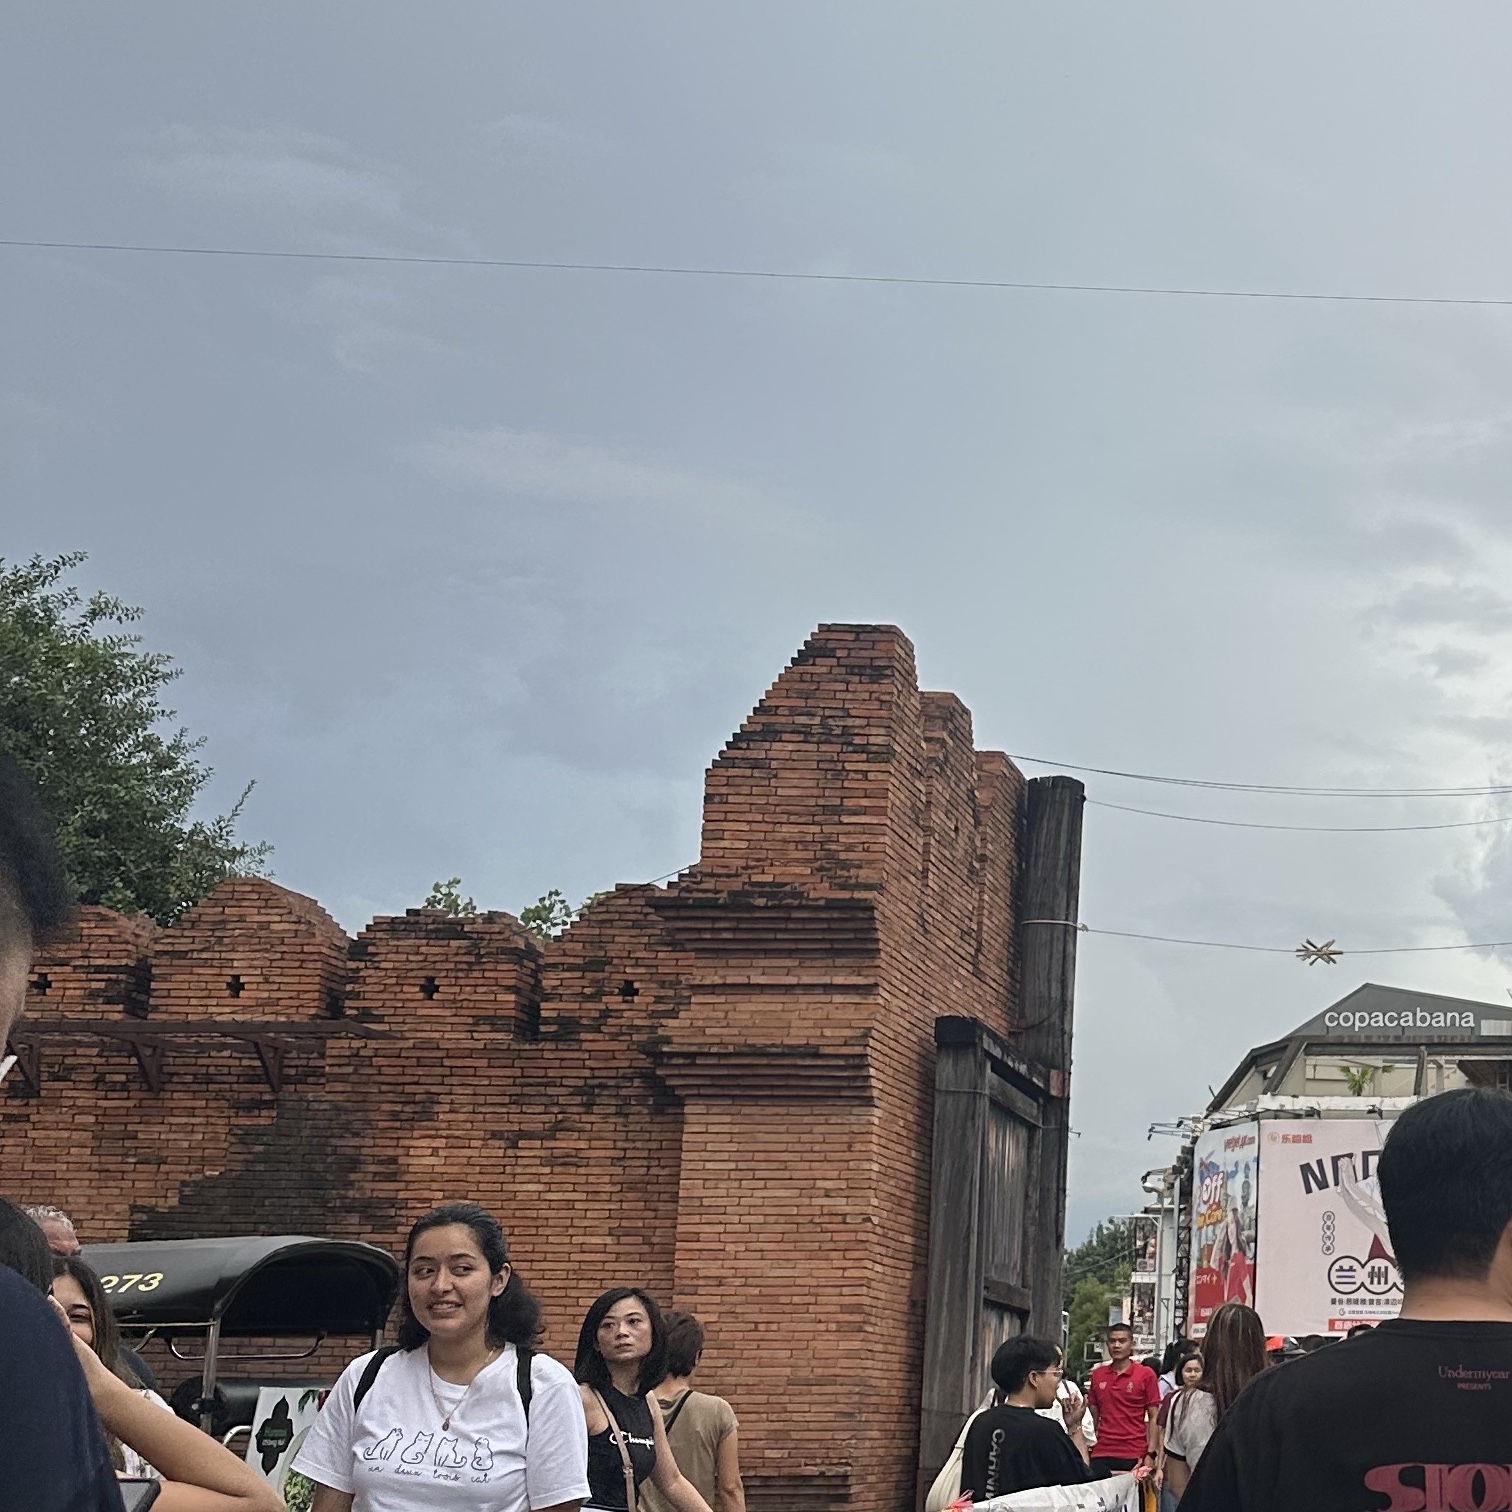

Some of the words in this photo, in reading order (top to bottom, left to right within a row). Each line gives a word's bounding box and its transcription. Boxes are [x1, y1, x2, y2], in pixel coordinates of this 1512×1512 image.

[1324, 1007, 1475, 1032] copacabana
[100, 1272, 164, 1294] 273
[1334, 1264, 1404, 1286] 兰州
[471, 1472, 492, 1484] cat
